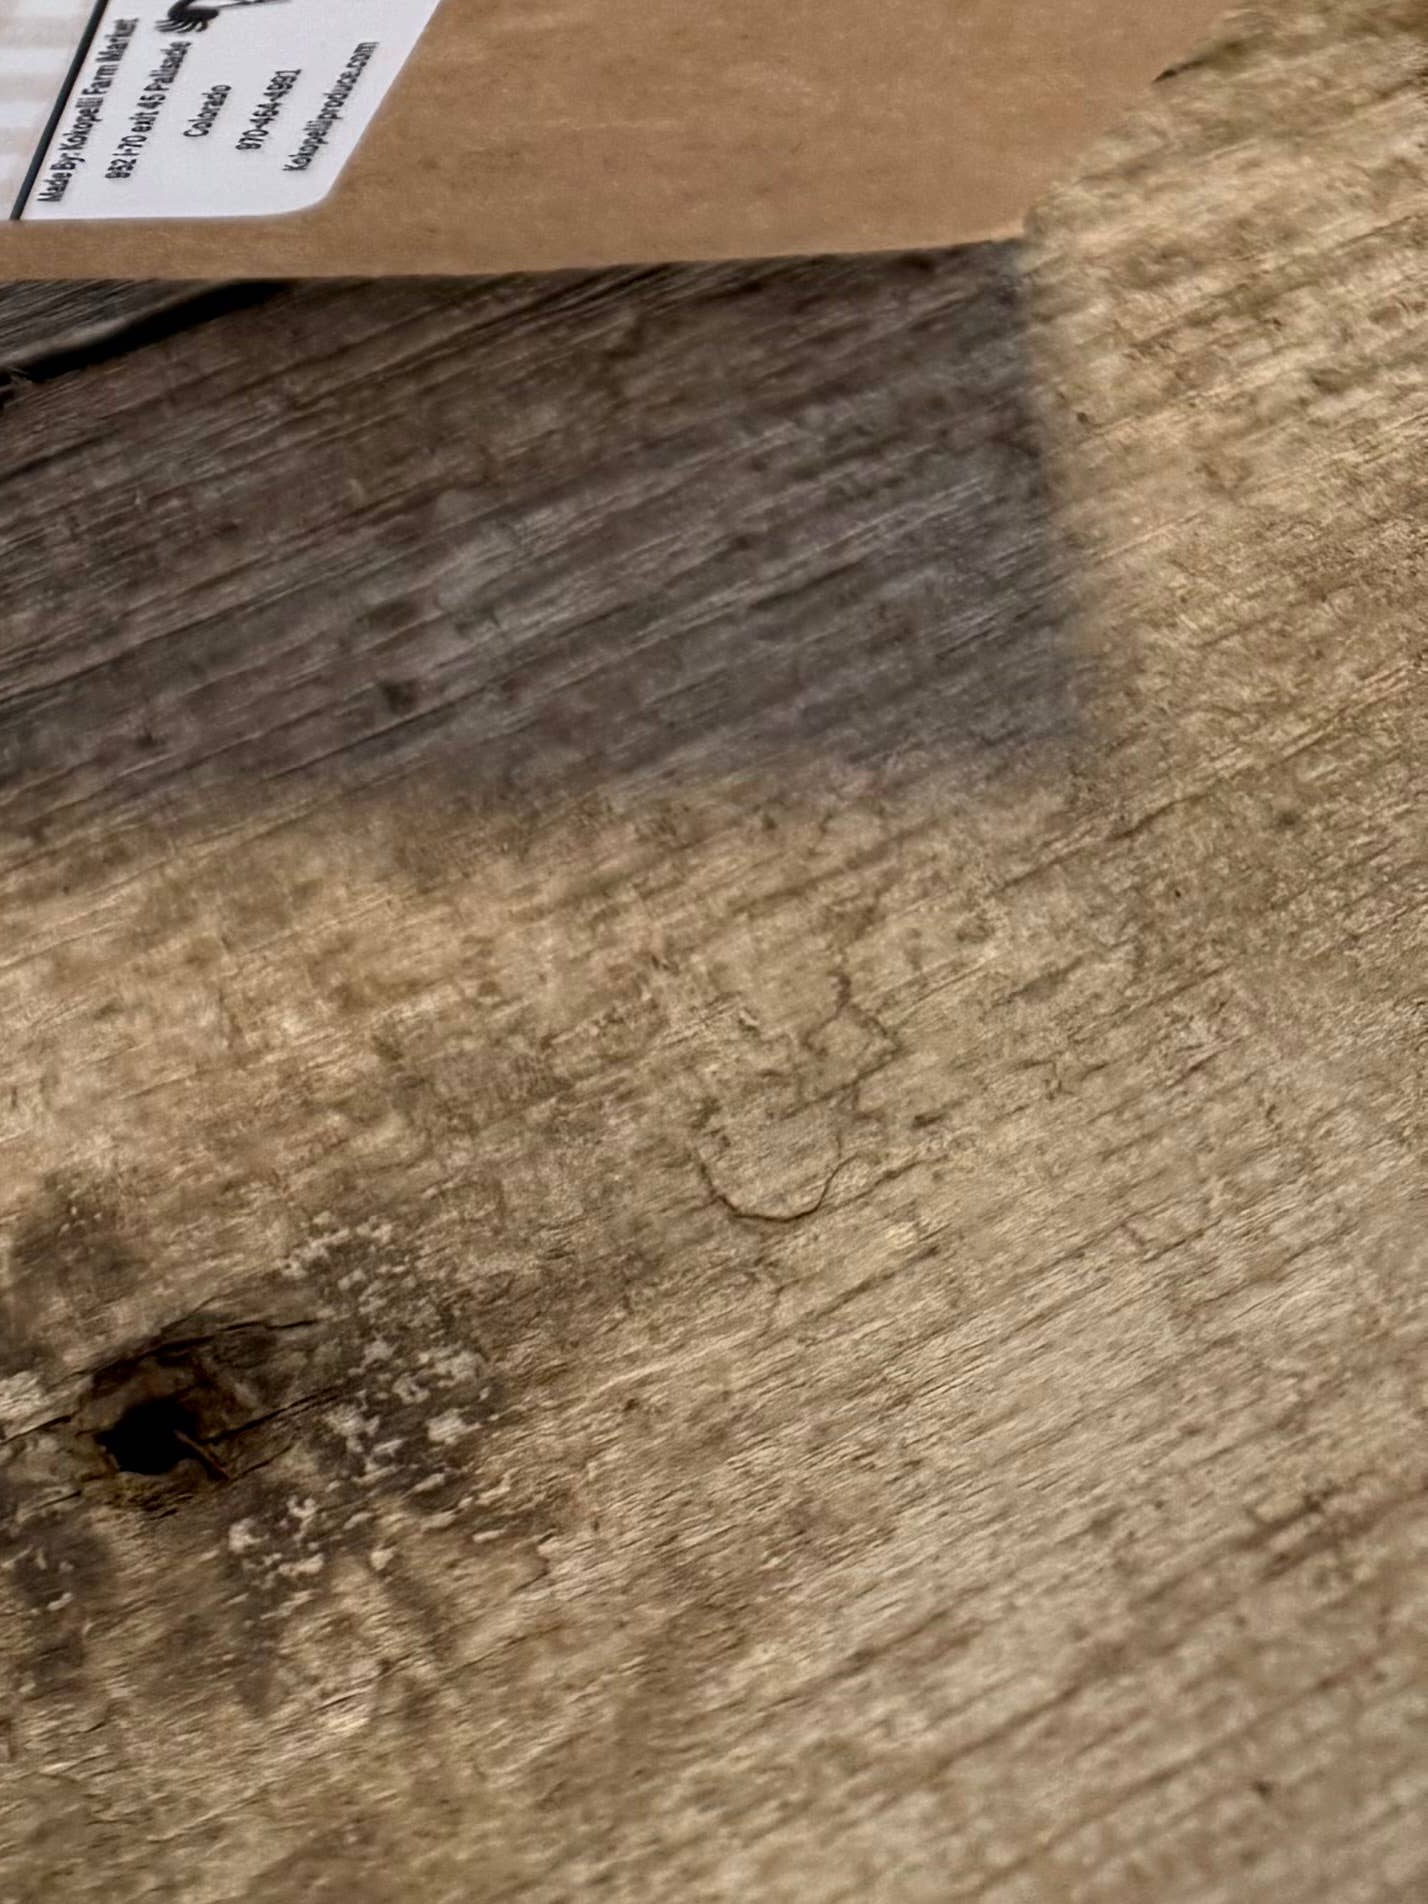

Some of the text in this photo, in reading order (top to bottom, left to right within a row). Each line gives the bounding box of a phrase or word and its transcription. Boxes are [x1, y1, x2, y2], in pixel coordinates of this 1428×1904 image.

[37, 172, 72, 202] Made
[82, 64, 119, 95] Farm
[183, 84, 232, 137] Colorado
